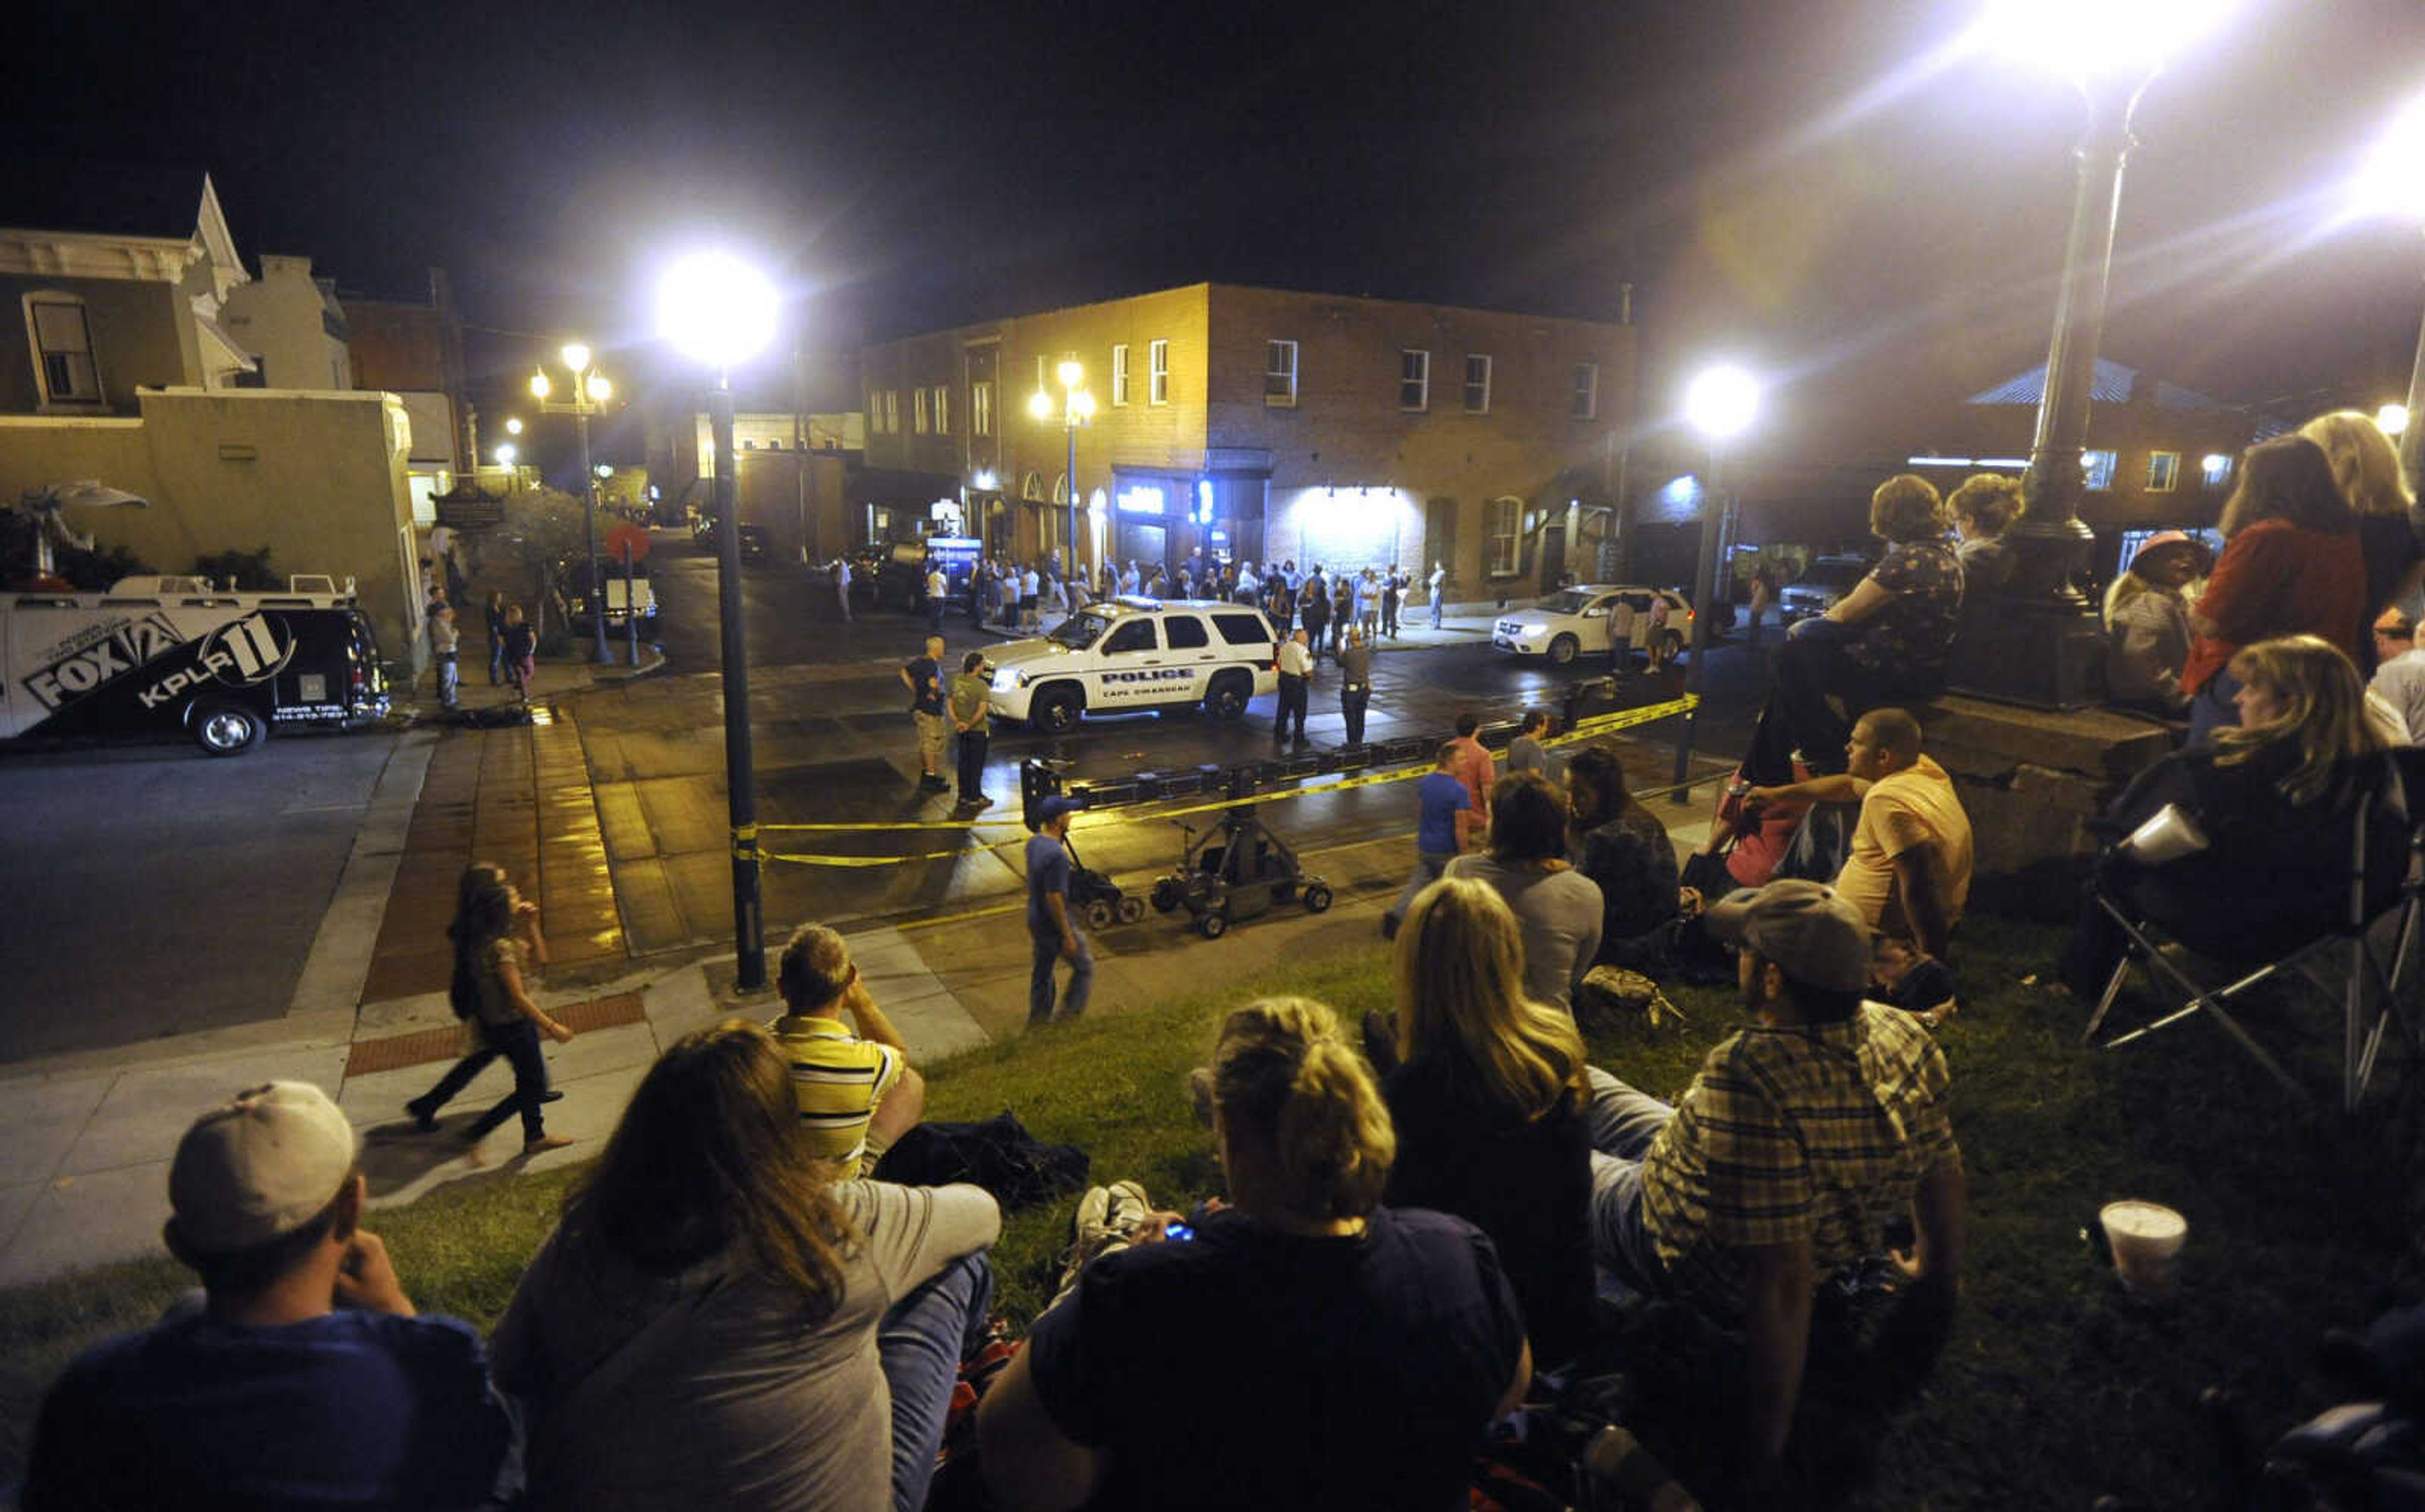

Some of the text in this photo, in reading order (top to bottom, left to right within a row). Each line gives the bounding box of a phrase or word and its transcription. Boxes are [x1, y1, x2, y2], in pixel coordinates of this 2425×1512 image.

[28, 641, 131, 707] FOX
[139, 614, 280, 708] KPLR 11
[1101, 669, 1194, 683] POLICE
